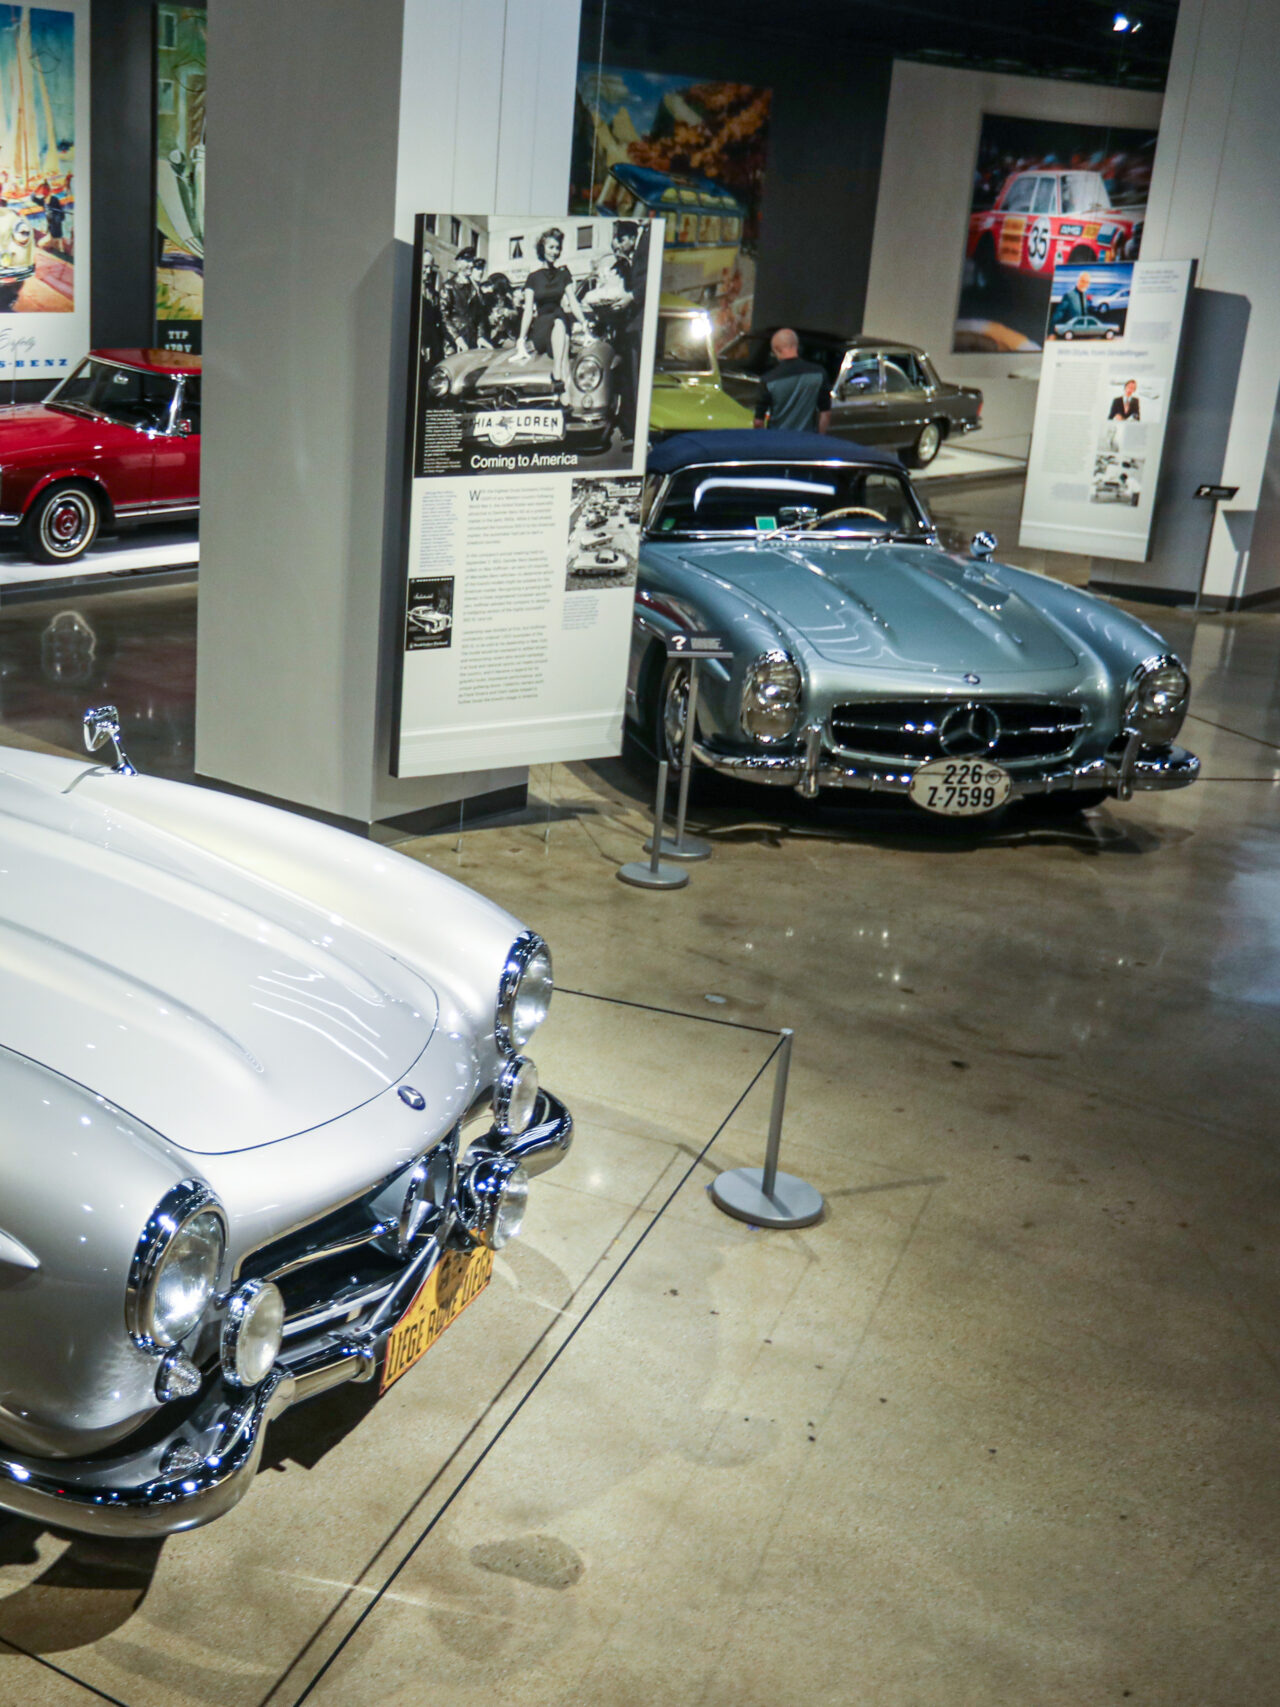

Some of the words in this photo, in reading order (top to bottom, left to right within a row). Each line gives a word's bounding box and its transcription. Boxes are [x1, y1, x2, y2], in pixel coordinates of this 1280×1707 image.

[1028, 226, 1049, 260] 35
[516, 415, 559, 428] LOREN
[470, 453, 517, 470] Coming
[517, 453, 530, 467] to
[530, 451, 579, 467] America
[942, 764, 983, 786] 226
[927, 786, 996, 808] Z-7599
[386, 1318, 425, 1381] LIEGE
